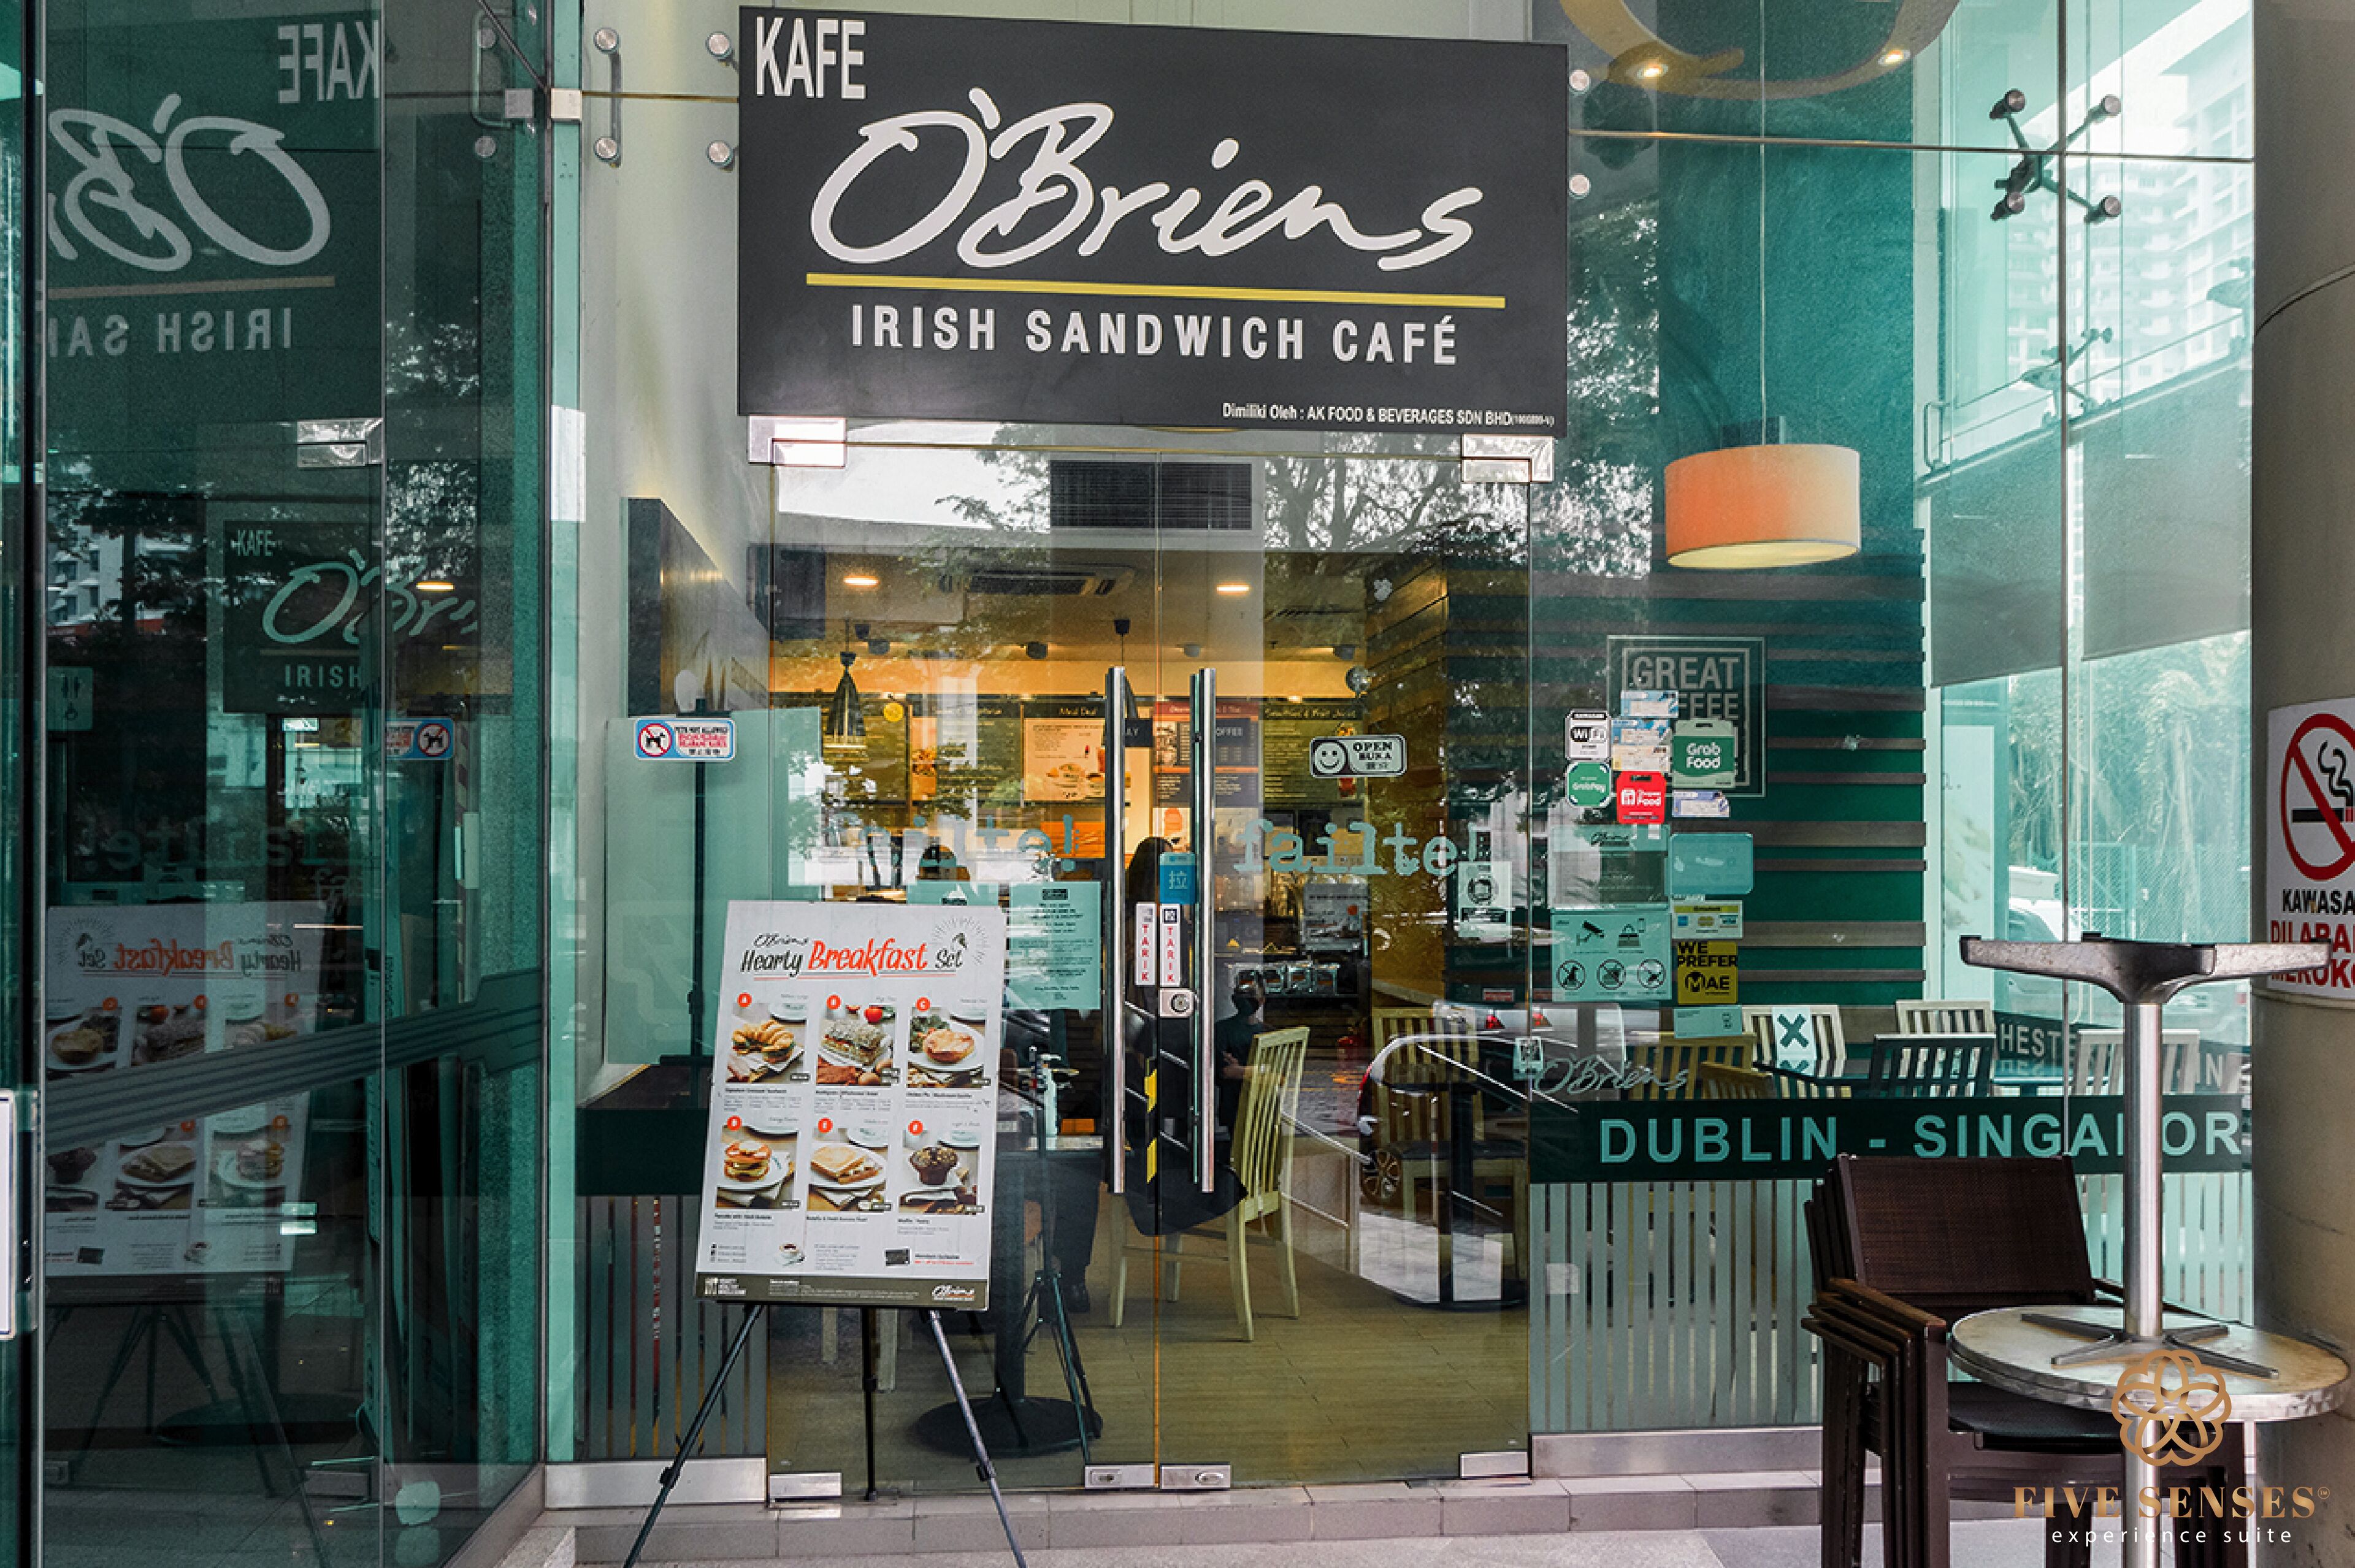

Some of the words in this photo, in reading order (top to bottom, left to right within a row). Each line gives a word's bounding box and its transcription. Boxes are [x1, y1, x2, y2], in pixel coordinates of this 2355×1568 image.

[755, 16, 866, 99] KAFE
[810, 87, 1483, 270] O'Briens
[852, 305, 995, 350] IRISH
[1025, 309, 1303, 360] SANDWICH
[1332, 315, 1457, 365] CAFÉ
[1270, 403, 1298, 420] Oleh
[1307, 405, 1325, 421] AK
[1328, 406, 1363, 422] FOOD
[1366, 407, 1375, 423] &
[1378, 408, 1454, 424] BEVERAGES
[1456, 410, 1482, 425] SDN
[238, 530, 274, 557] KAFE
[1633, 656, 1740, 689] GREAT
[1352, 742, 1393, 752] OPEN
[1686, 742, 1721, 755] Grab
[1686, 756, 1720, 768] Food
[740, 949, 803, 977] Hearty
[808, 938, 928, 976] Breakfast
[935, 949, 963, 969] Set
[1141, 924, 1150, 982] TARIK
[1677, 941, 1709, 955] WE
[1677, 954, 1738, 967] PREFER
[1684, 971, 1730, 993] MAE
[1599, 1117, 1837, 1163] DUBLIN
[1913, 1112, 2242, 1158] SINGAOR
